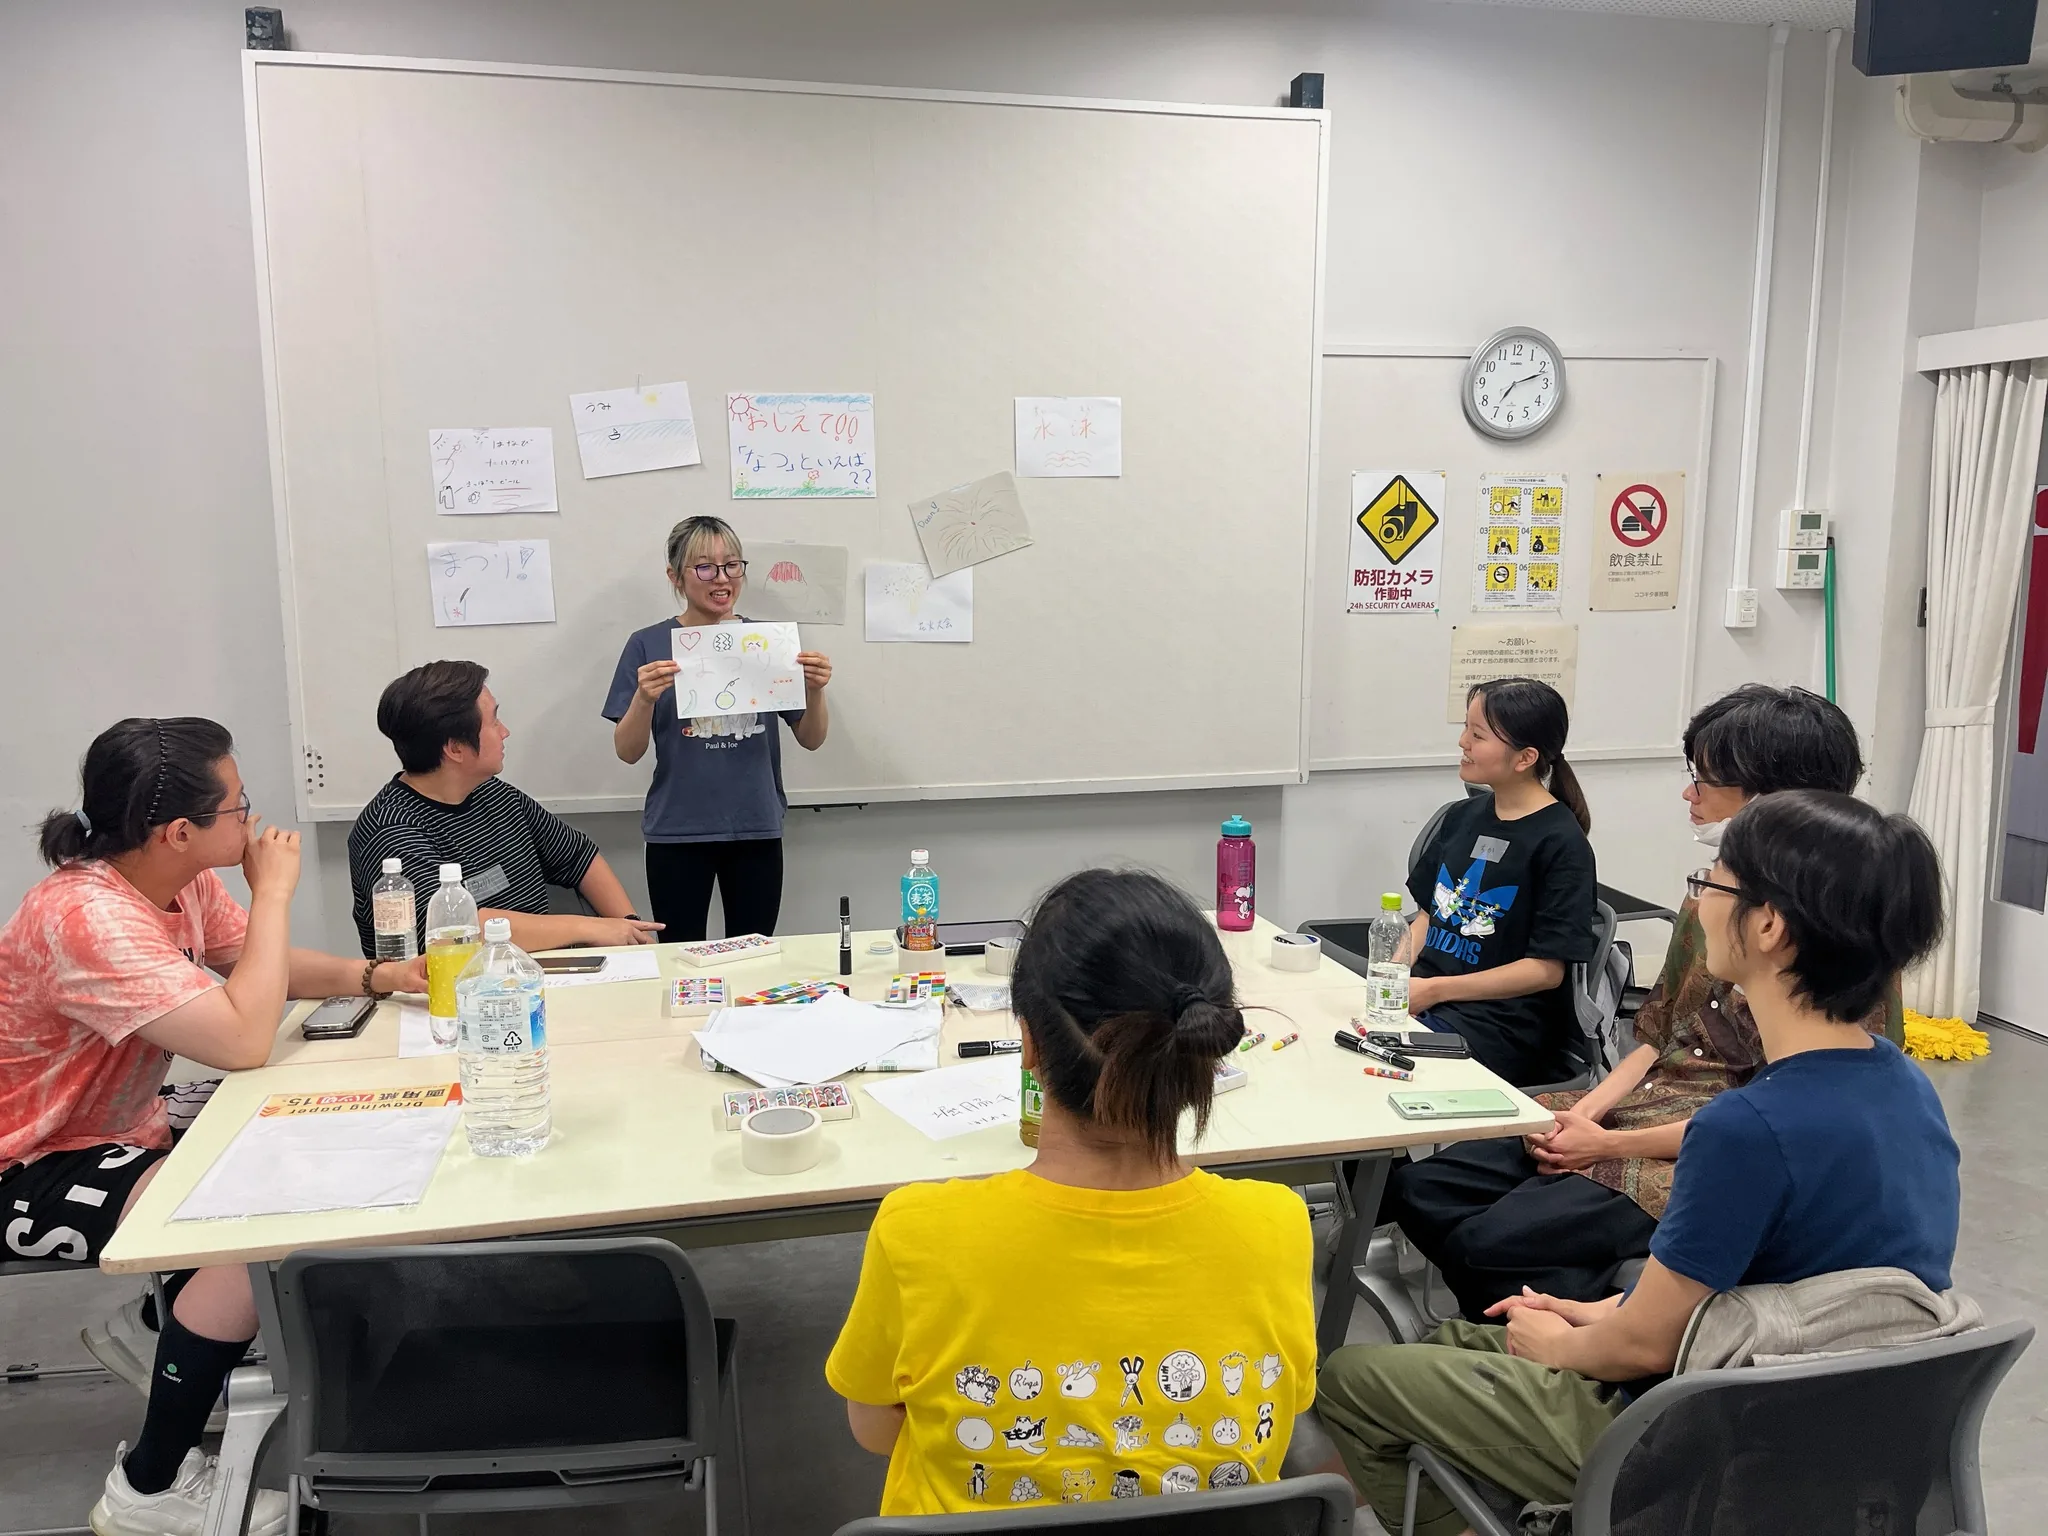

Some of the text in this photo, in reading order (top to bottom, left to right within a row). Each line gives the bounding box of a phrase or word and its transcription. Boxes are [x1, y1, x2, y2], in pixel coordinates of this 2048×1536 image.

[1498, 349, 1507, 360] 11
[1512, 344, 1523, 356] 12
[1530, 349, 1534, 361] 1
[1485, 361, 1496, 372] 10
[1539, 361, 1548, 373] 2
[1479, 377, 1486, 389] 9
[1541, 378, 1549, 389] 3
[1481, 395, 1489, 406] 8
[1534, 395, 1541, 406] 4
[585, 402, 611, 412] うみ
[1493, 406, 1500, 418] 7
[1522, 406, 1529, 418] 5
[1507, 411, 1514, 422] 6
[1033, 416, 1096, 440] 水泳
[1481, 487, 1490, 495] 01
[1480, 527, 1489, 535] 03
[1521, 527, 1530, 535] 04
[1609, 552, 1663, 567] 飲食禁止
[1477, 563, 1487, 571] 05
[1518, 563, 1528, 571] 06
[1353, 569, 1434, 586] 防犯カメラ
[1374, 587, 1413, 601] 作動中
[1350, 602, 1364, 610] 24h
[1401, 601, 1435, 609] CAMERAS
[911, 892, 933, 905] 麦茶
[1425, 925, 1481, 965] DIDAS
[289, 1097, 312, 1106] 15
[288, 1101, 424, 1115] Drawing paper
